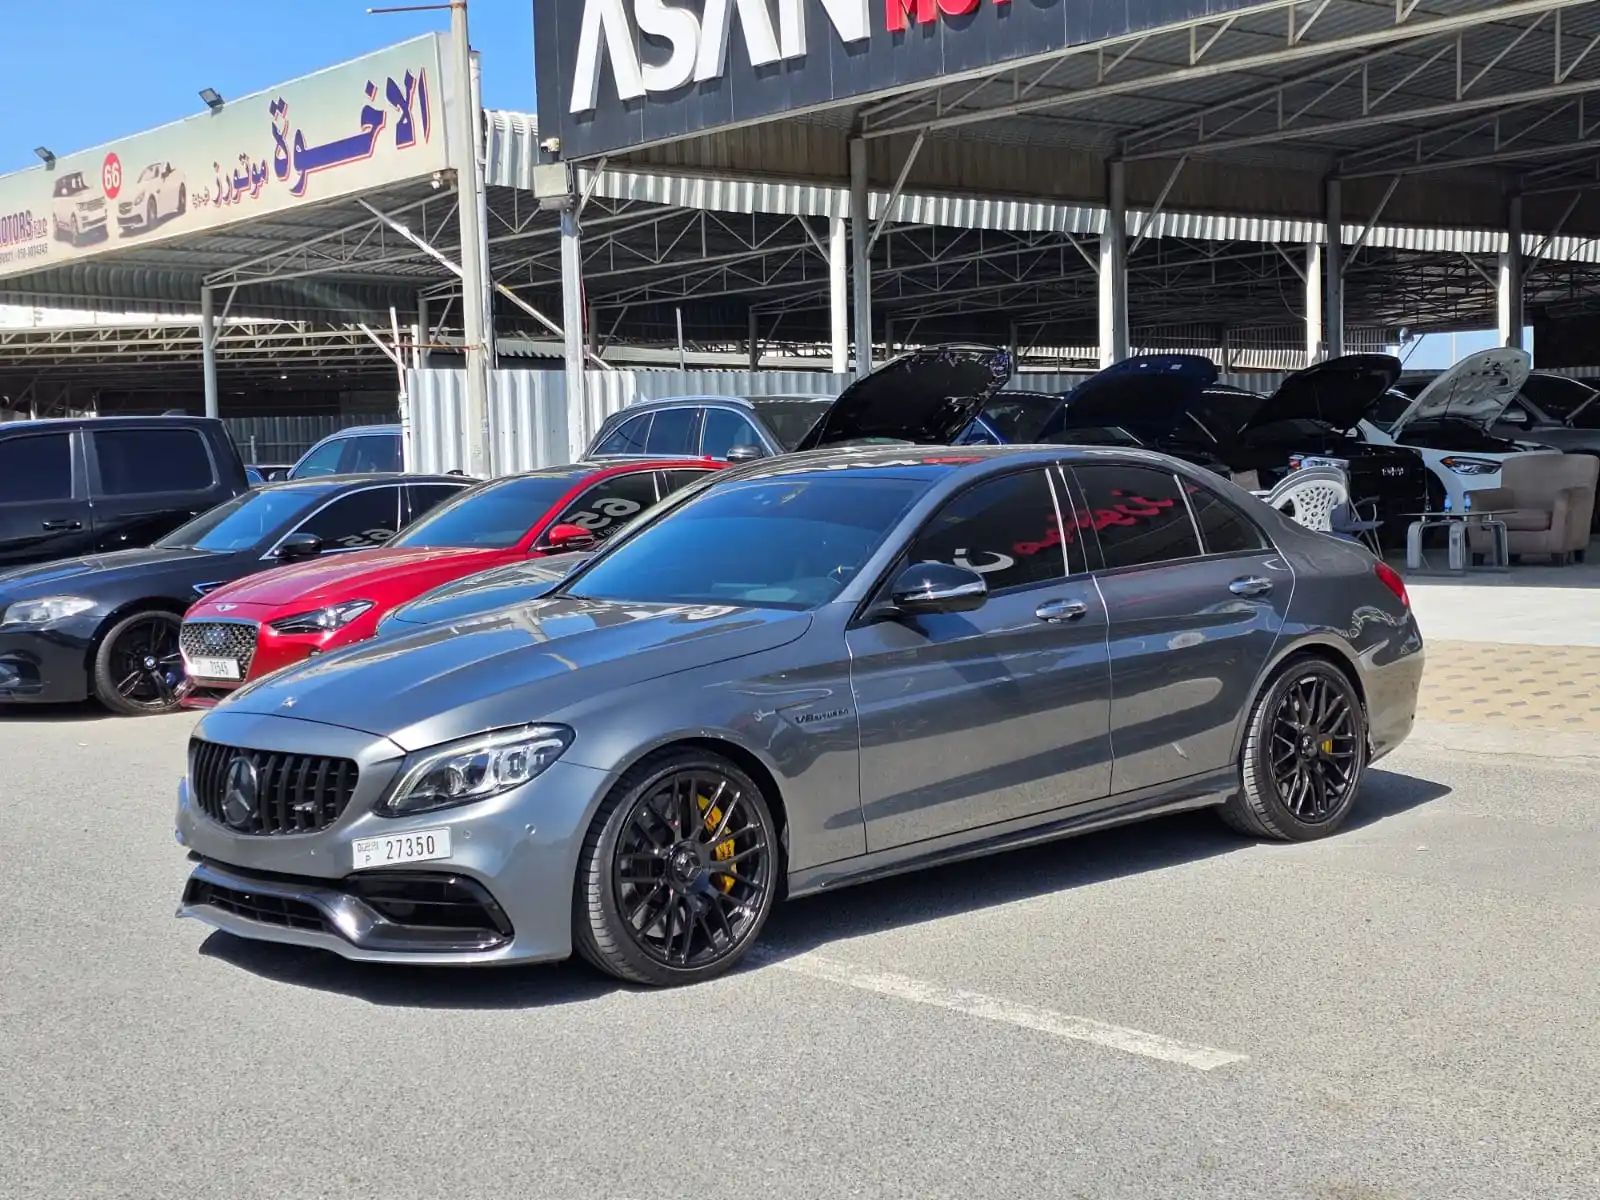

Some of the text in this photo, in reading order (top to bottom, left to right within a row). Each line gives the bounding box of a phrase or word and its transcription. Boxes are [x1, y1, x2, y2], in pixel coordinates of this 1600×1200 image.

[102, 163, 121, 189] 66
[0, 209, 33, 248] OTORS
[386, 835, 435, 860] 27350
